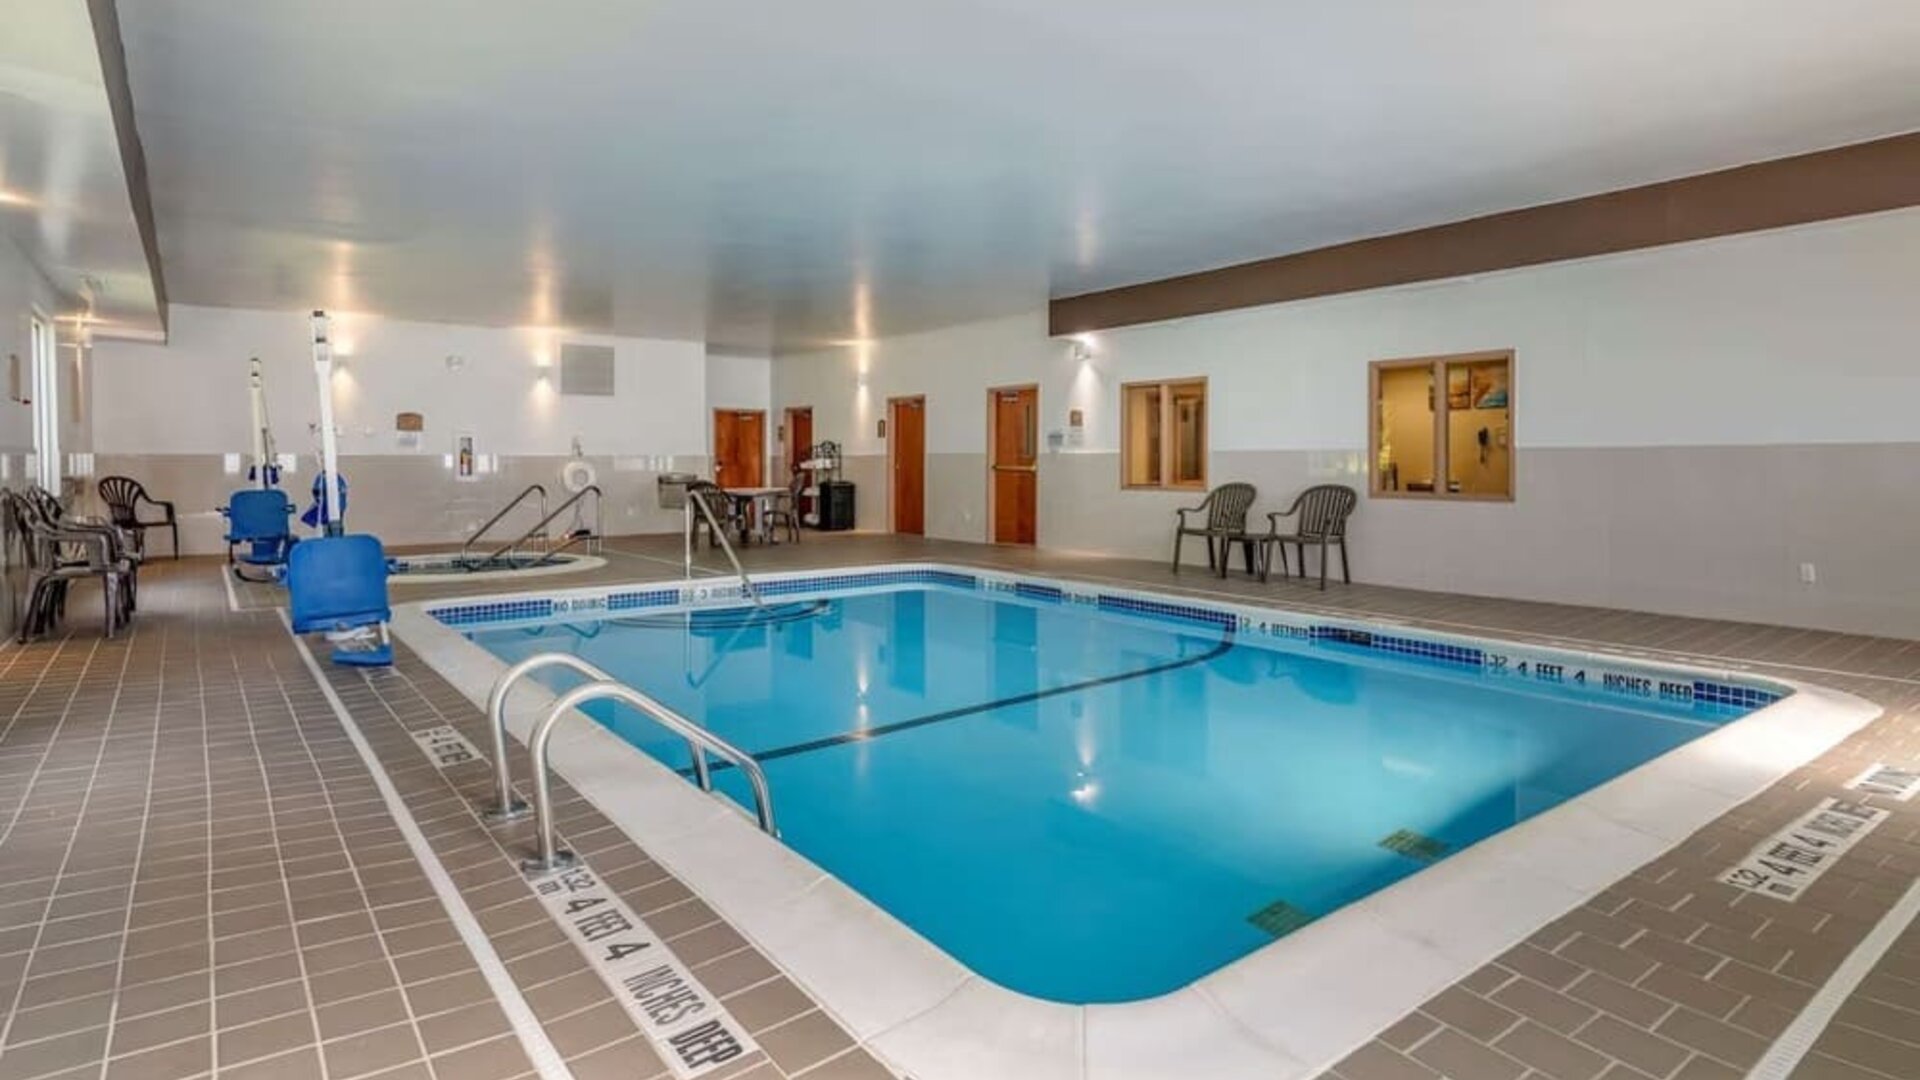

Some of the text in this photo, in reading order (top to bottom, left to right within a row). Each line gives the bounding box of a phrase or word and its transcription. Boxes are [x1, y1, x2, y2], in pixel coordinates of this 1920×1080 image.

[1757, 859, 1808, 876] 4
[564, 897, 744, 1069] 4 FEET 4 INCHES DEEP
